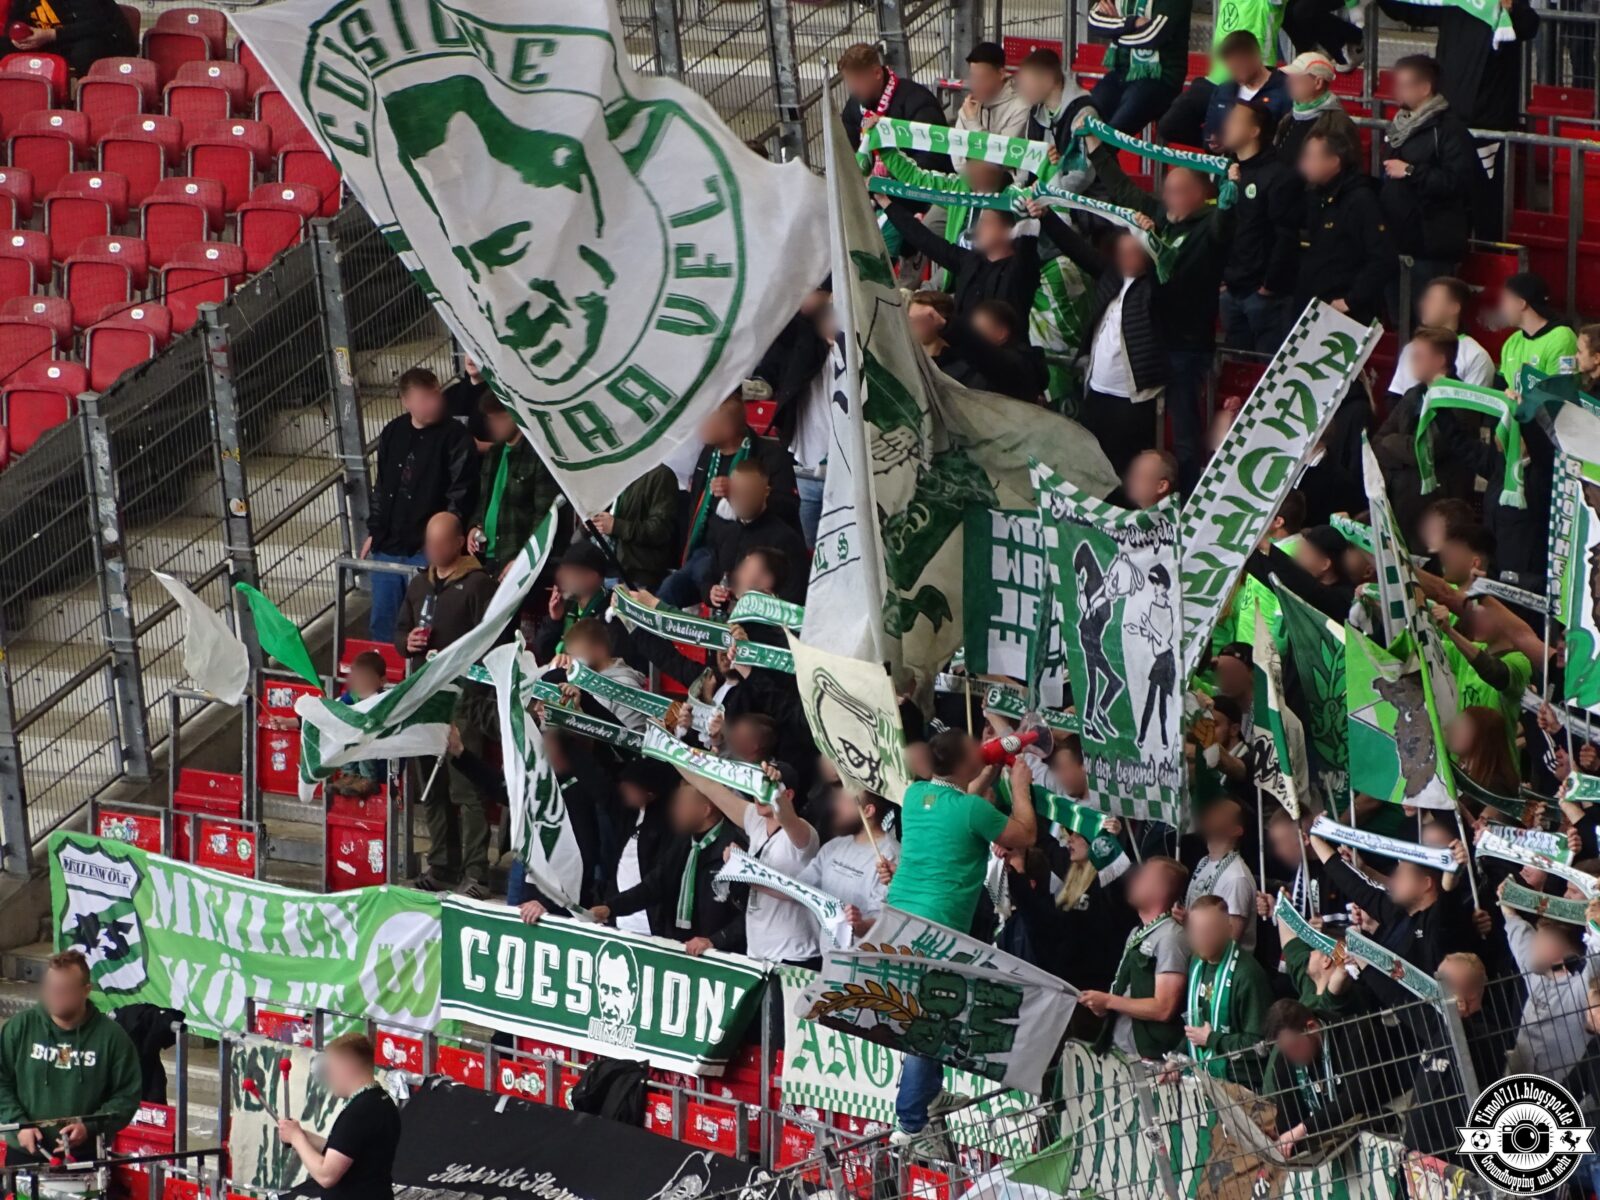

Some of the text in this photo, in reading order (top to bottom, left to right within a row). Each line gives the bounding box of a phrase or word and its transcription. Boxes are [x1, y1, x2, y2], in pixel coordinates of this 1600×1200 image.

[1113, 129, 1230, 171] WOLFSBURG
[664, 616, 710, 643] Pokalsieger
[145, 865, 359, 961] MEILEN
